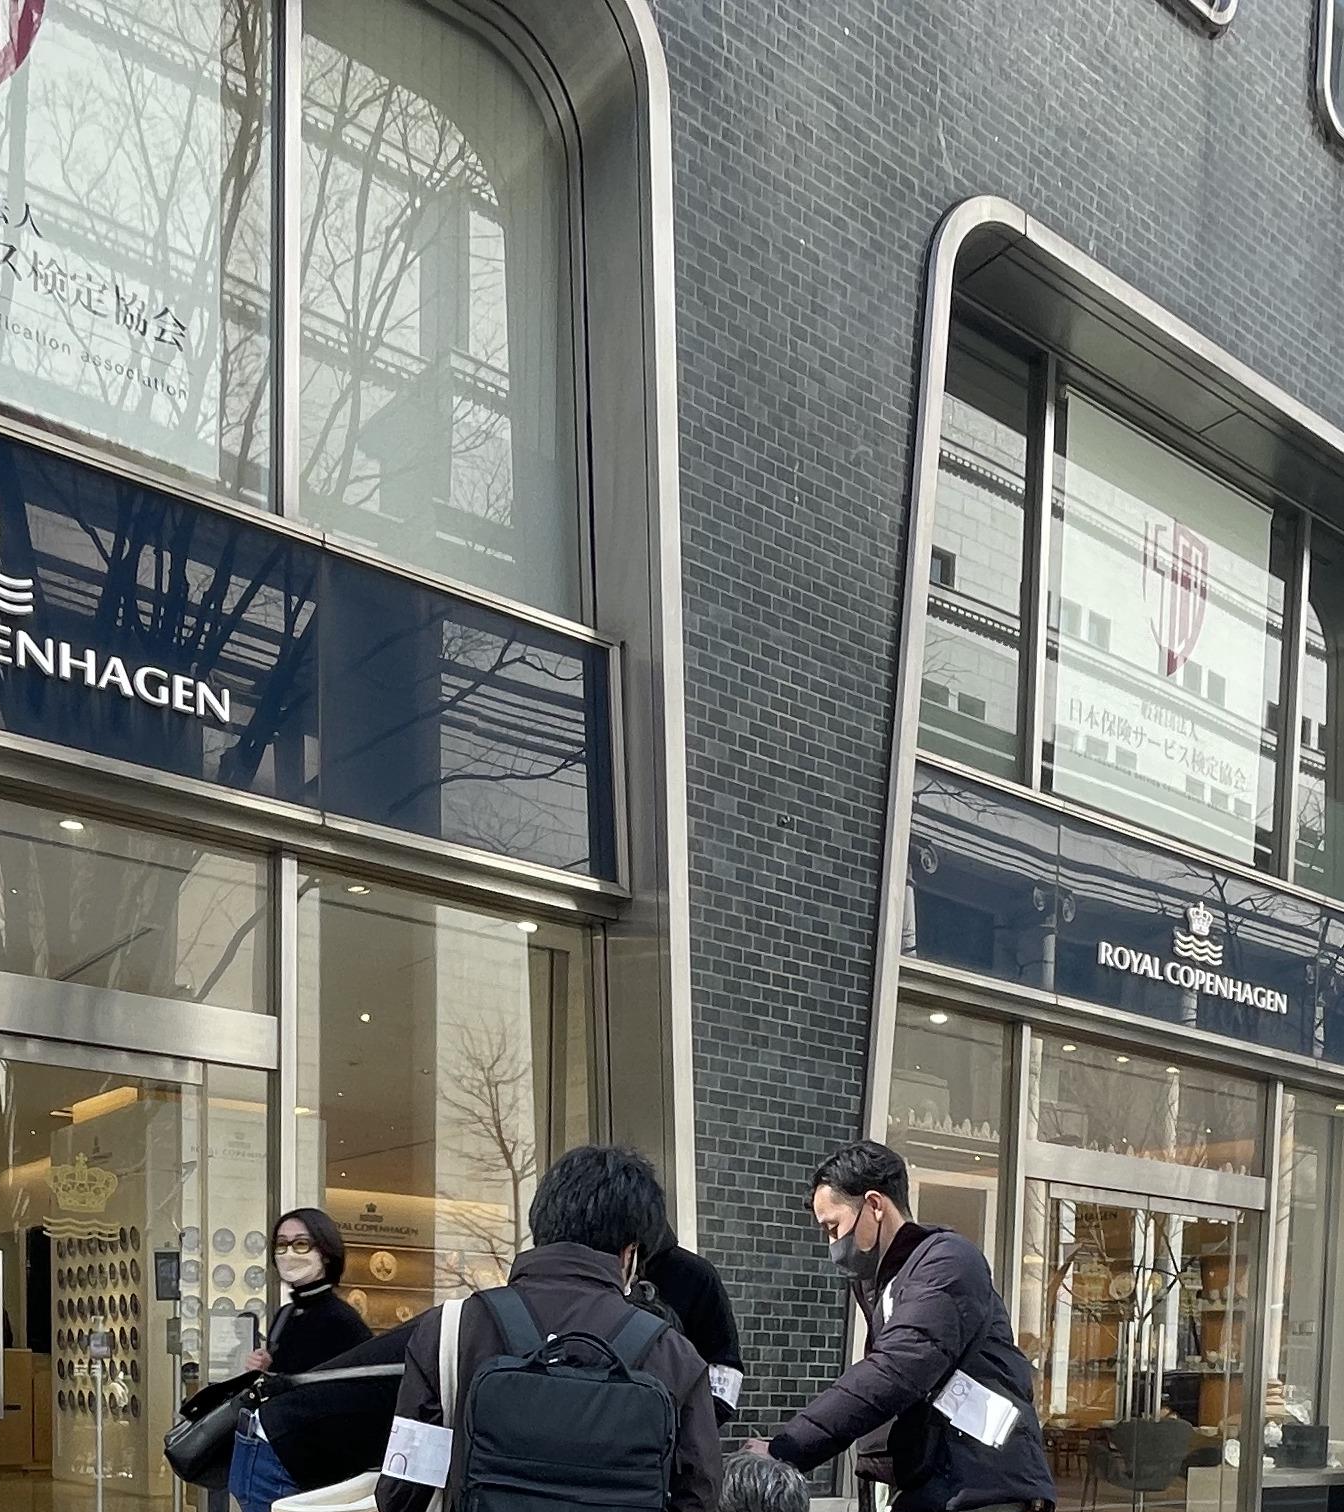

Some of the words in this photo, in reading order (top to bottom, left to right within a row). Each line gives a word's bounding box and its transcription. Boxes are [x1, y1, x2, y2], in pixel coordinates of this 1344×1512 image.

[81, 351, 188, 400] association
[1098, 942, 1163, 980] ROYAL
[1164, 962, 1288, 1015] COPENHAGEN
[354, 1223, 419, 1235] COPENHAGEN
